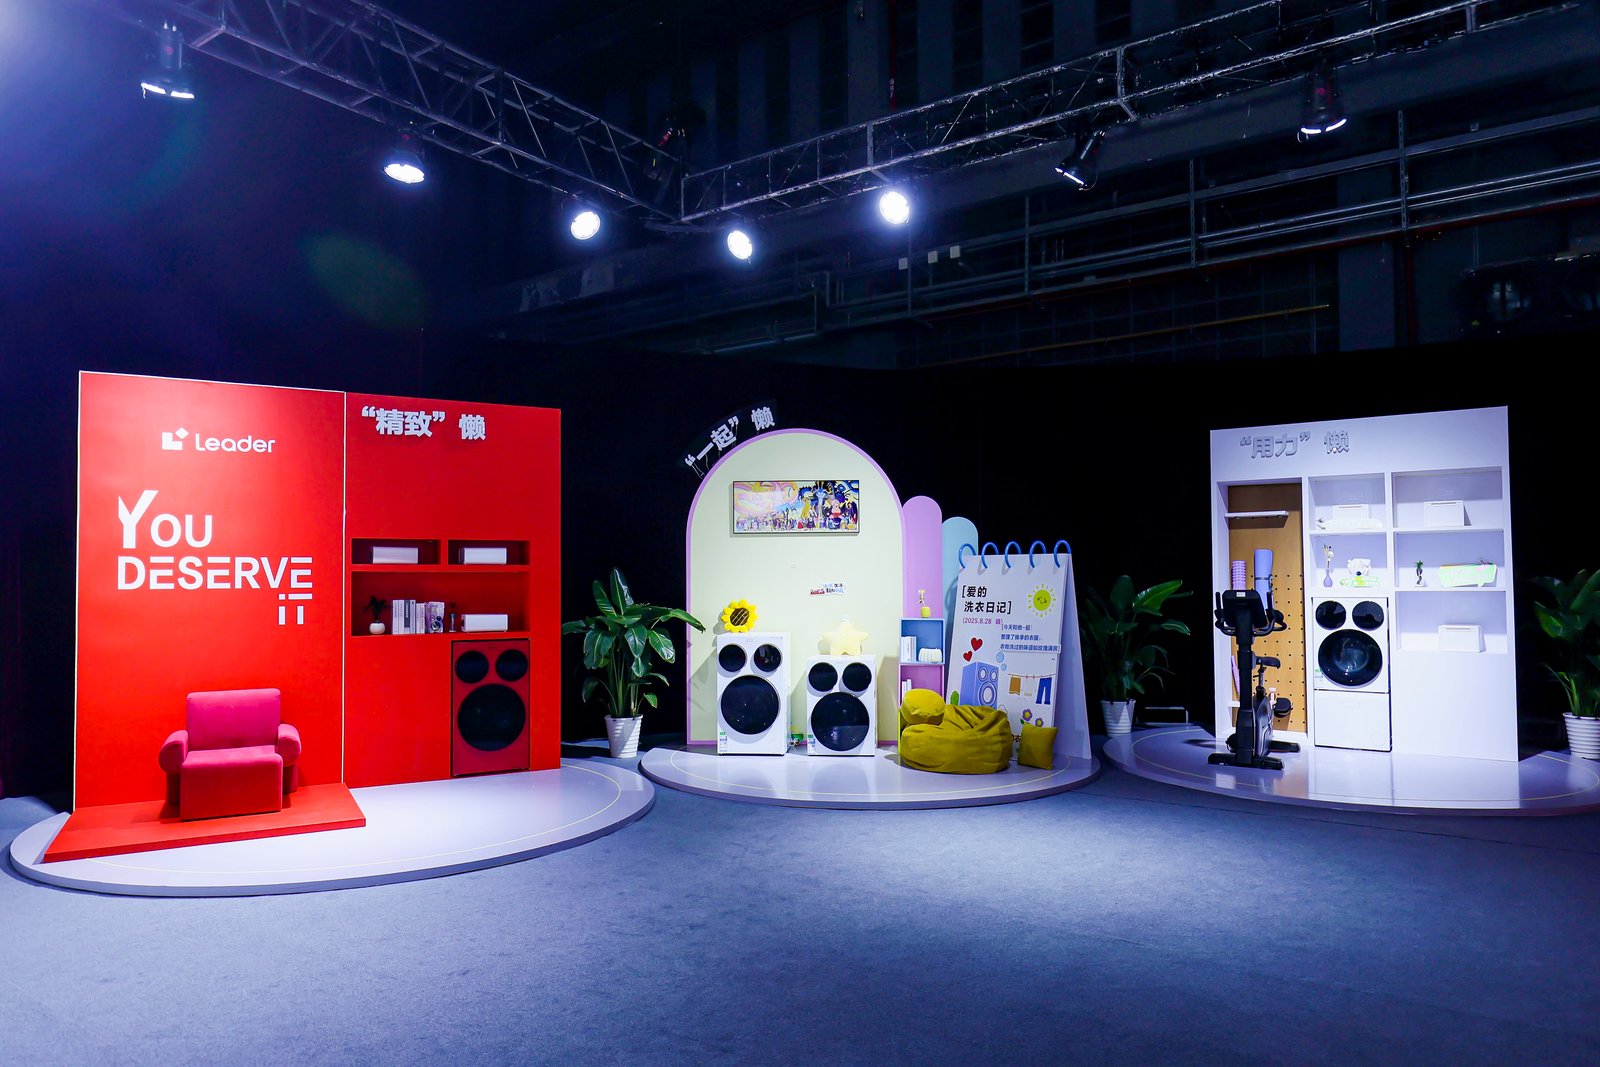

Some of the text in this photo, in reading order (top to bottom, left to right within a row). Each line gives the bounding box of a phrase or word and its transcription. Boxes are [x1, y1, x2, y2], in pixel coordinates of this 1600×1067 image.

[361, 405, 487, 440] “精致” 懒
[684, 406, 776, 467] “一起” 懒
[195, 432, 276, 453] Leader
[1240, 429, 1350, 459] “用力” 懒
[117, 556, 313, 590] DESERVE
